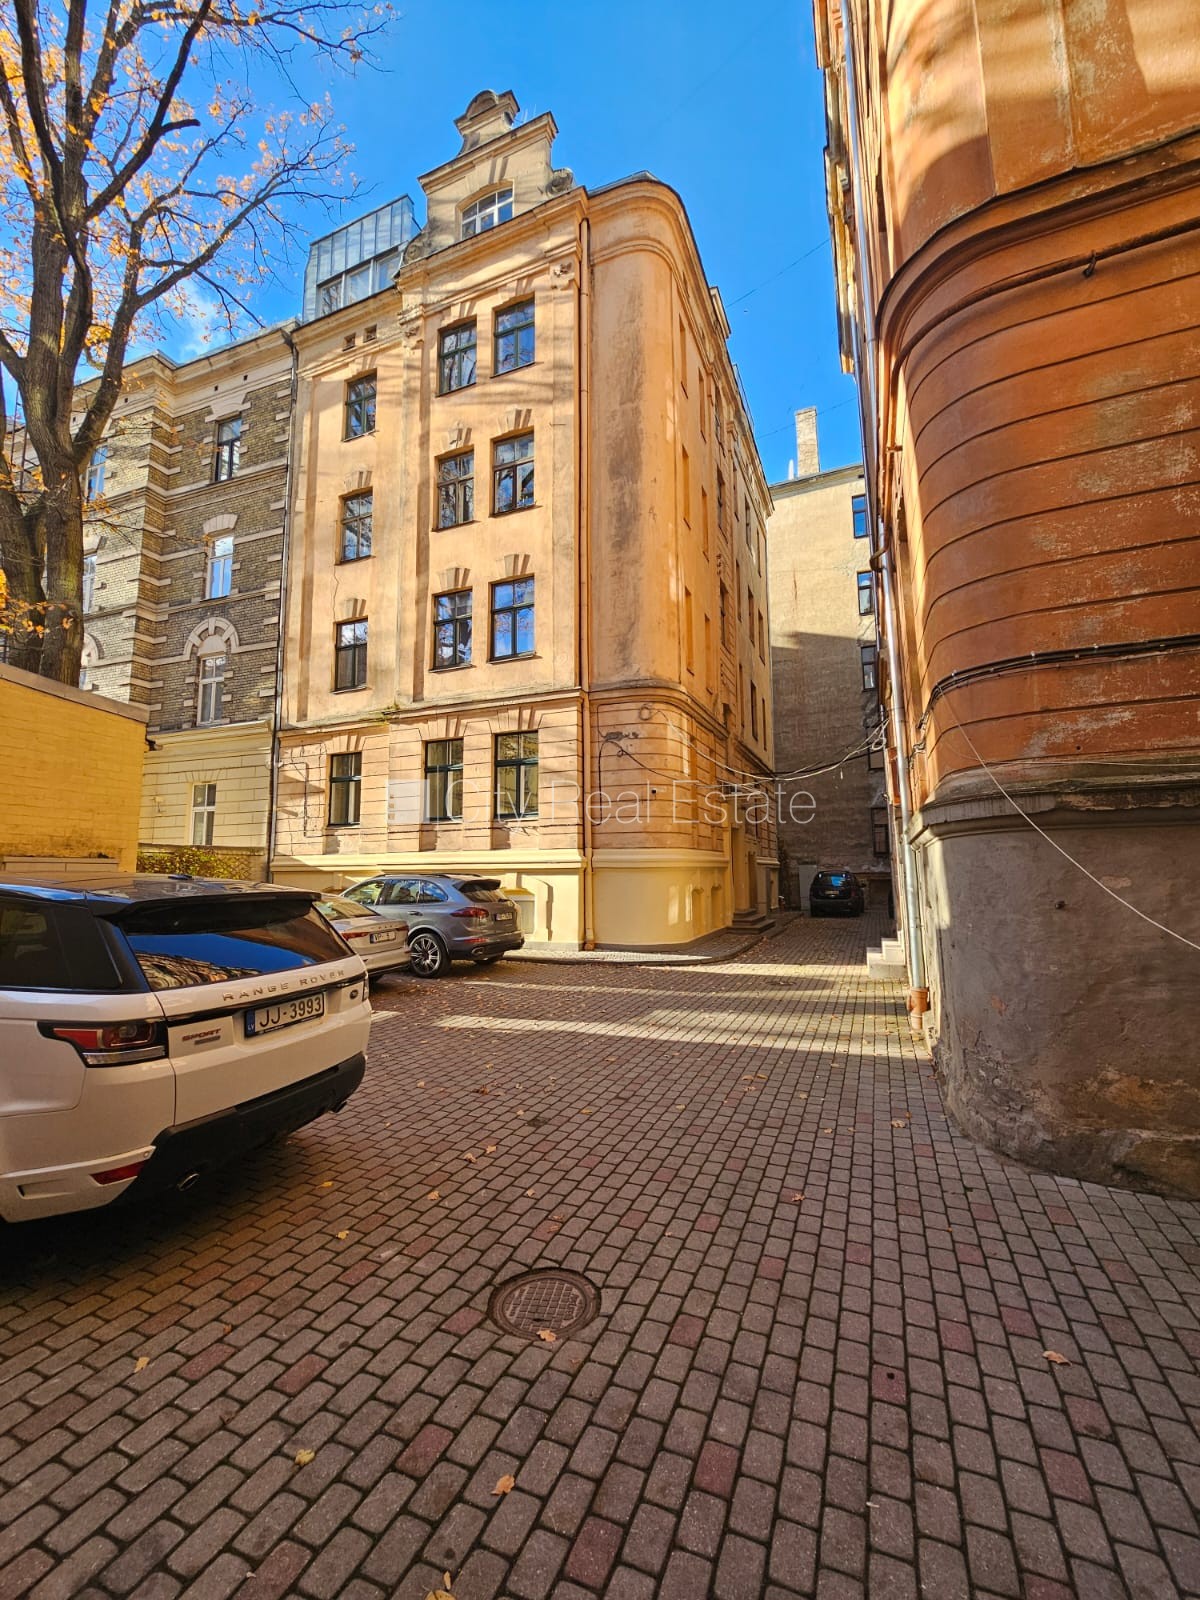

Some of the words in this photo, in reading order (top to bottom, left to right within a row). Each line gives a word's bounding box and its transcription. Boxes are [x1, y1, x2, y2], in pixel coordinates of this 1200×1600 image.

[223, 982, 289, 1001] RANGE
[300, 970, 345, 986] ROVER
[259, 996, 321, 1027] JJ-3993
[182, 1028, 221, 1041] SPORT
